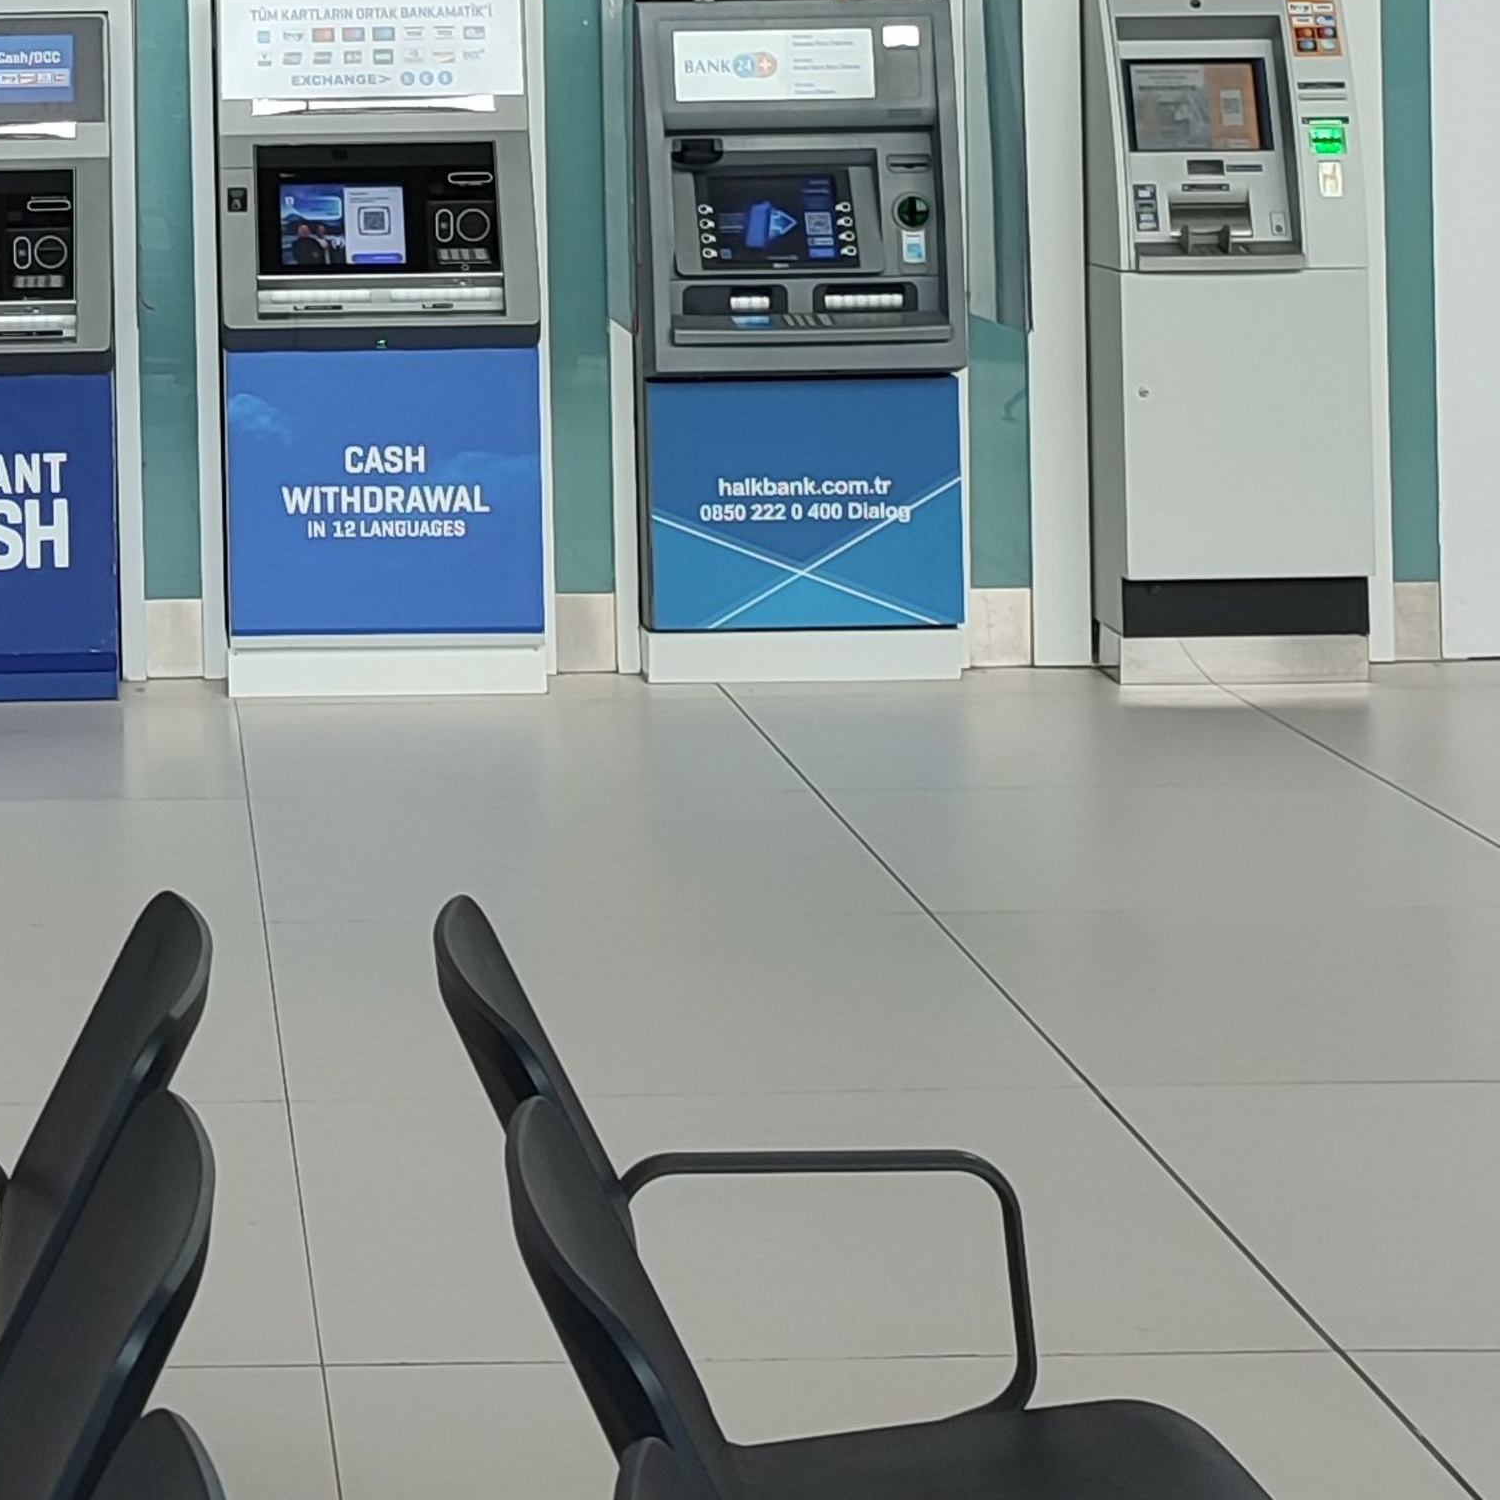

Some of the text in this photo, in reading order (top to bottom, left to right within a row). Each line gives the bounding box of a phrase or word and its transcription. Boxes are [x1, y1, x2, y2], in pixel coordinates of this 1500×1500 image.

[250, 7, 278, 22] TÜM
[281, 7, 353, 21] KARTLARIN
[356, 6, 398, 20] ORTAK
[683, 59, 732, 74] BANK
[344, 445, 426, 474] CASH
[717, 476, 892, 498] halkbank.com.tr
[281, 484, 491, 515] WITHDRAWAL
[699, 502, 912, 523] 0850 222 0 400 Dialog
[307, 519, 466, 538] IN 12 LANGUAGES
